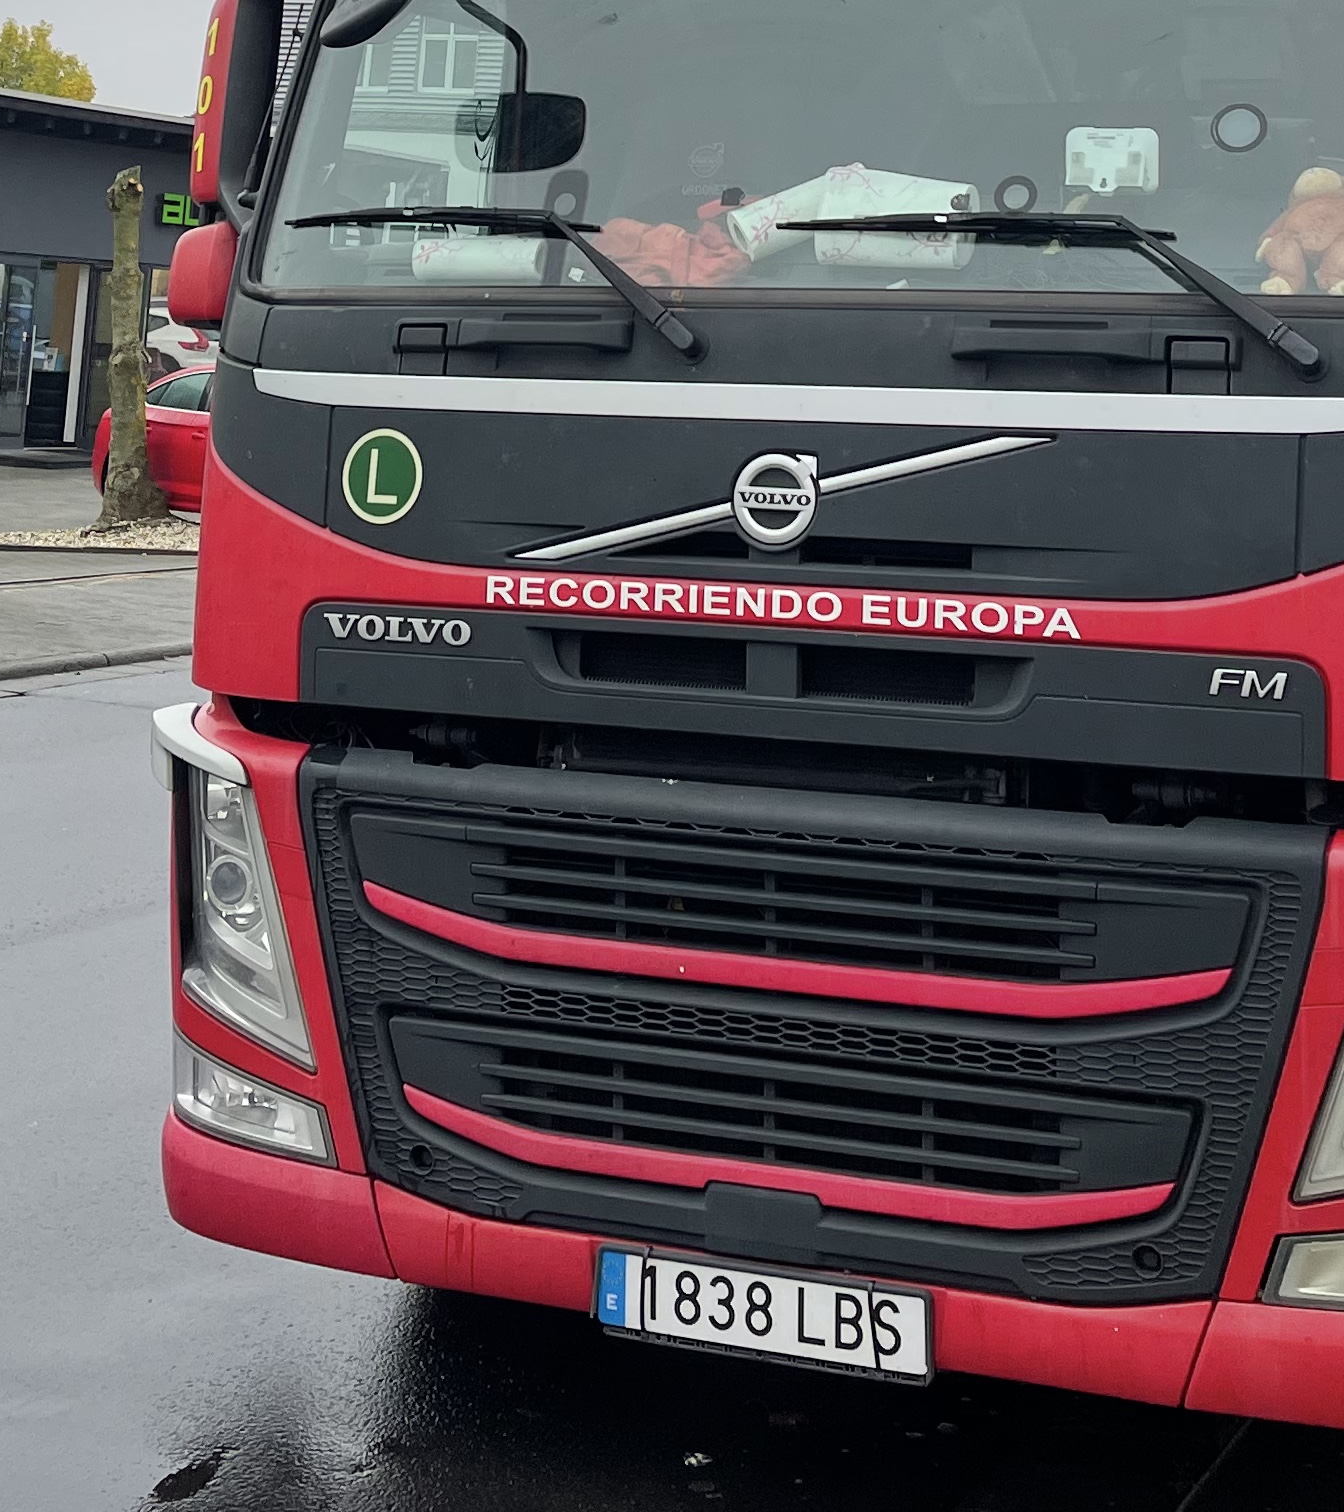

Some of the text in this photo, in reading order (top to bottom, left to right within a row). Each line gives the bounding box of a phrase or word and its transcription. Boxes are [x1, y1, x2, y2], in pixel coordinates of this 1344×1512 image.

[366, 448, 398, 505] L
[738, 491, 811, 506] VOLVO
[323, 612, 472, 646] VOLVO
[485, 574, 1081, 640] RECORRIENDO EUROPA
[1208, 668, 1288, 700] FM
[643, 1264, 773, 1336] 1838
[797, 1286, 902, 1356] LBS
